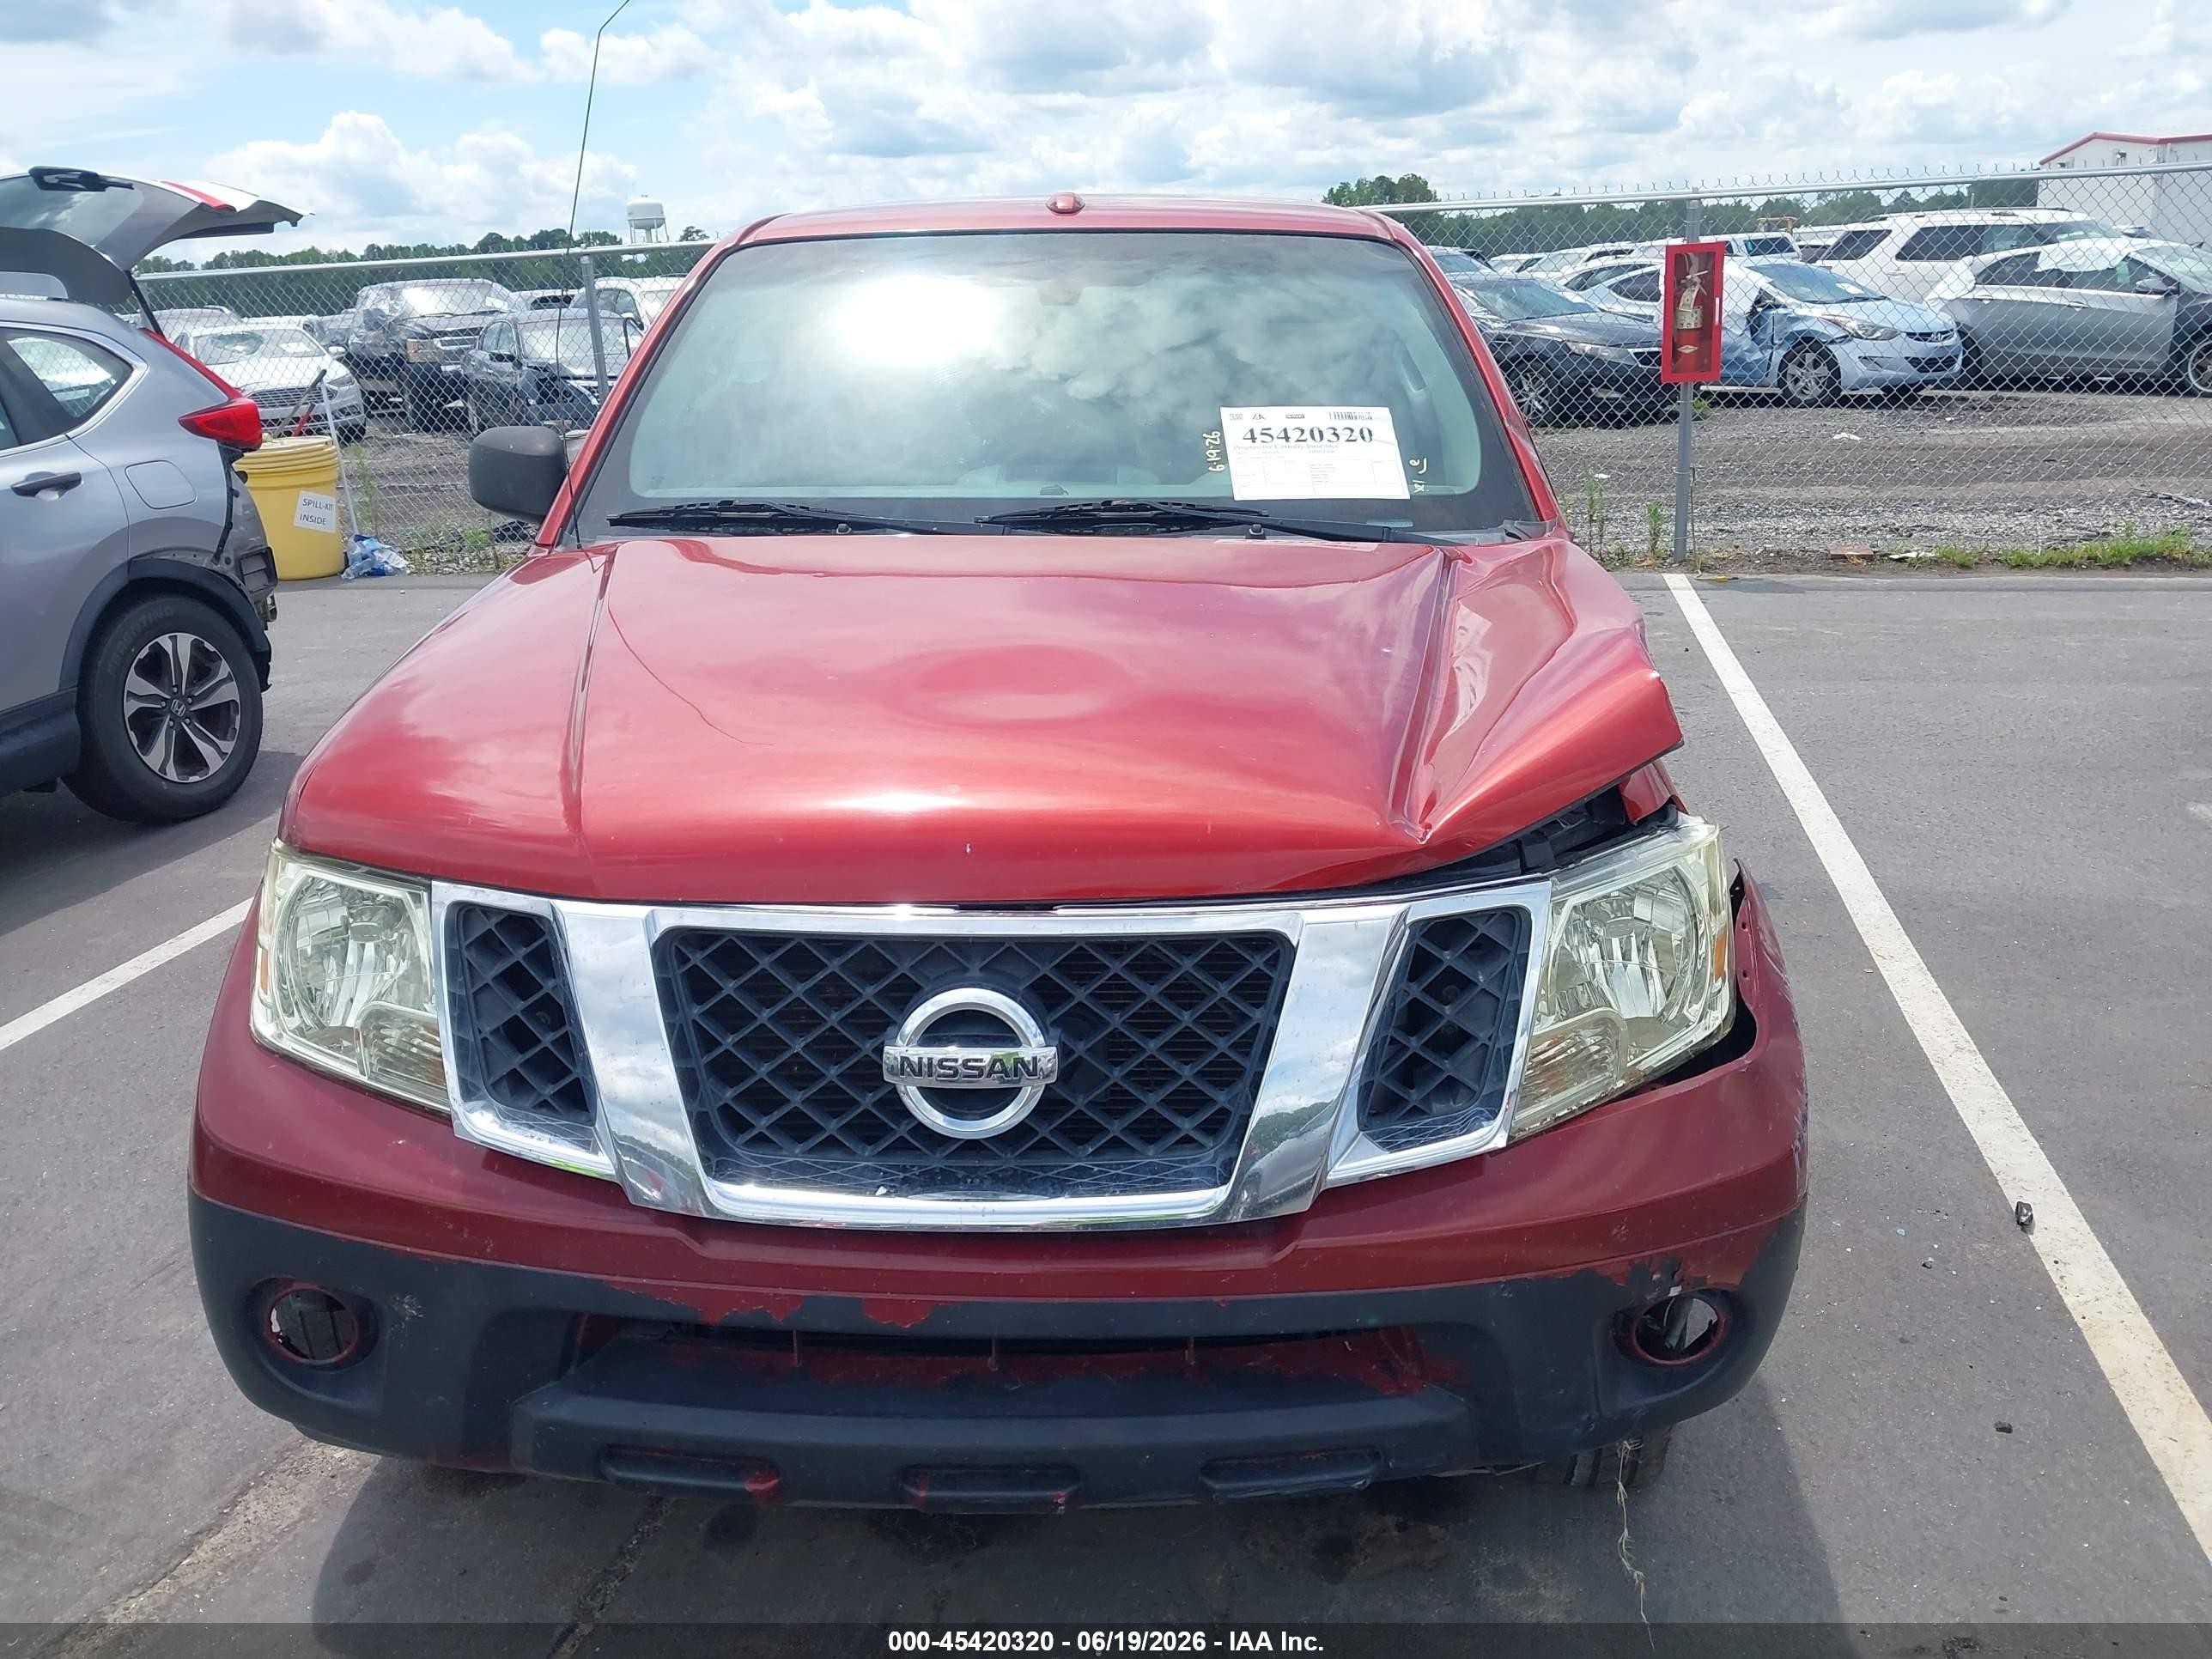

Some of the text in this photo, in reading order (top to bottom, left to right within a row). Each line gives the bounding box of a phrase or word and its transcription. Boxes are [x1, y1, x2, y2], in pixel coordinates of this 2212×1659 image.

[1243, 426, 1373, 444] 45420320
[299, 514, 326, 525] INSIDE
[899, 1055, 1038, 1080] NISSAN
